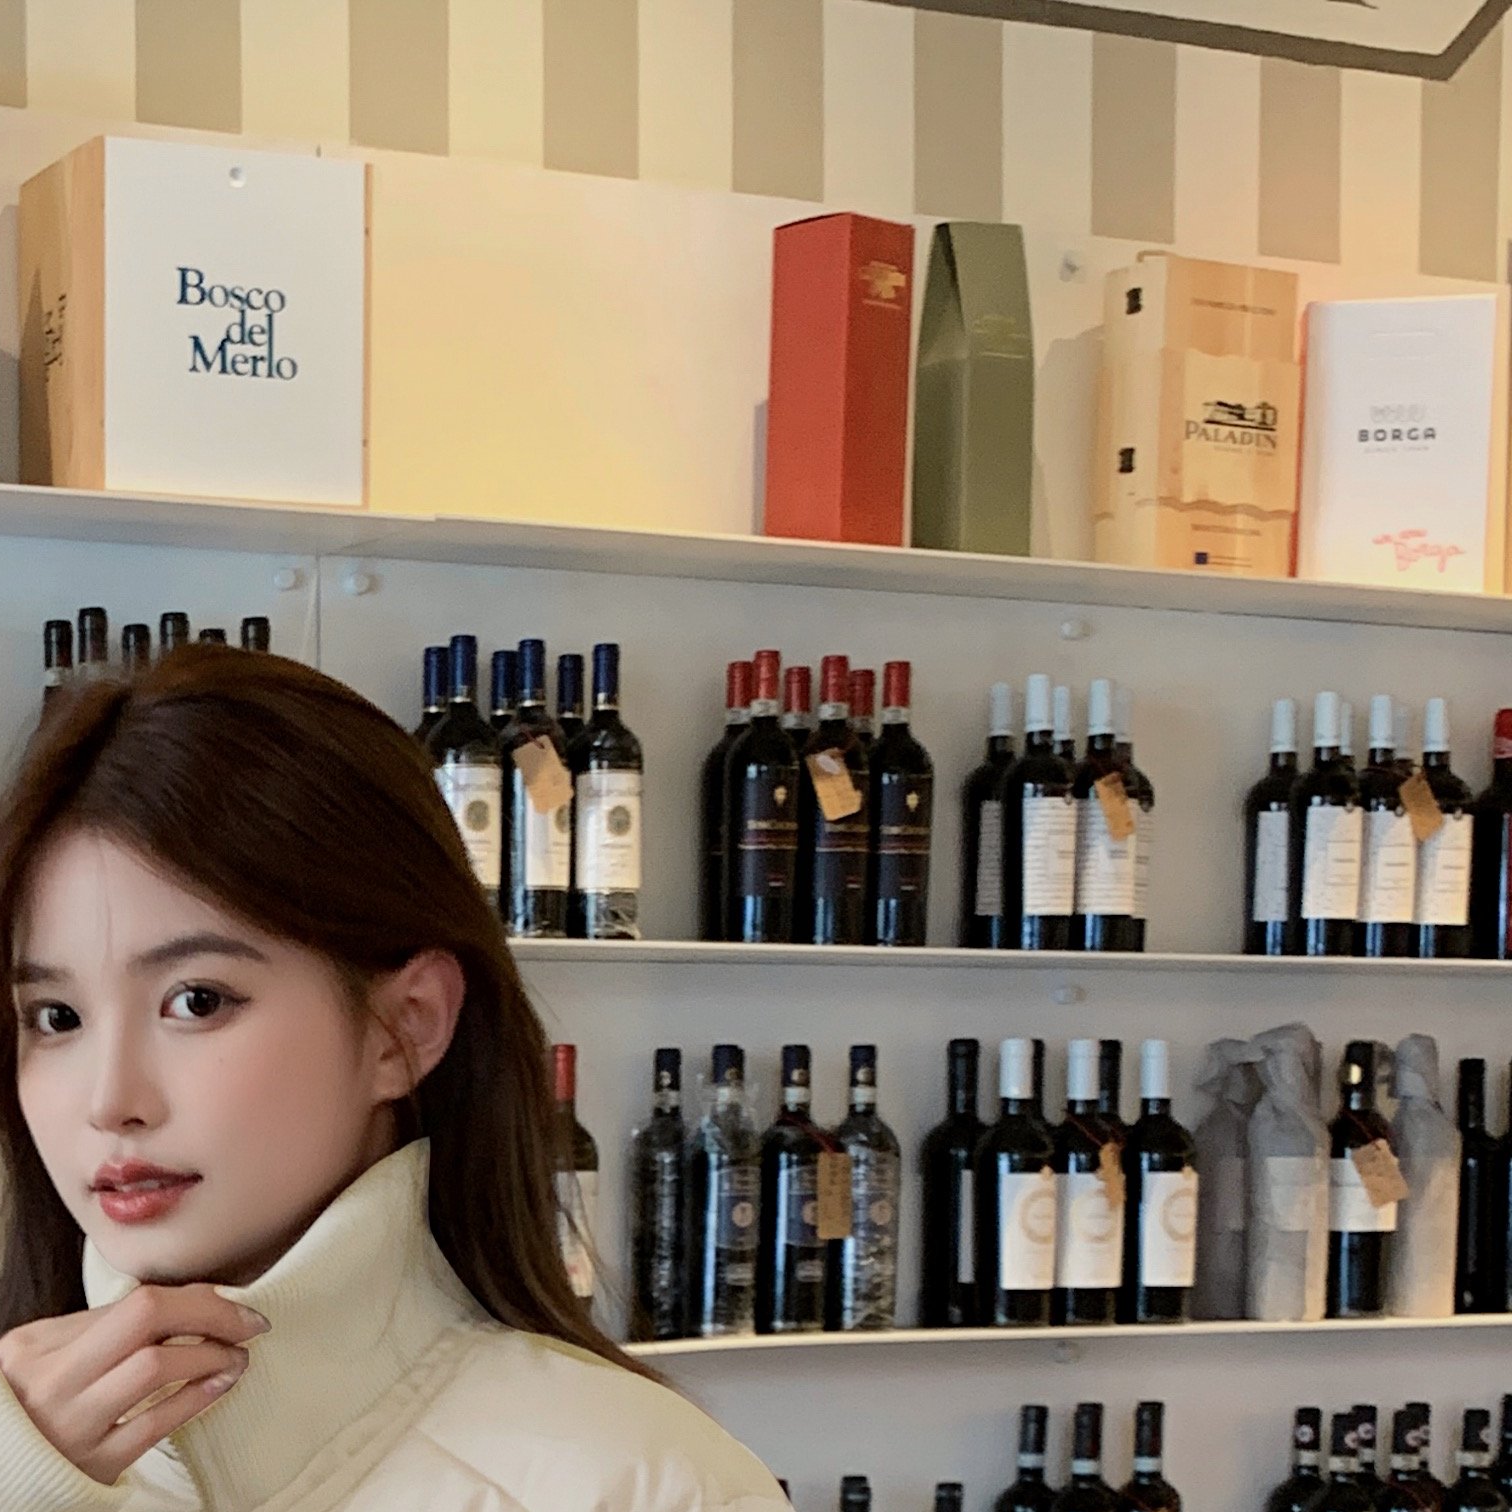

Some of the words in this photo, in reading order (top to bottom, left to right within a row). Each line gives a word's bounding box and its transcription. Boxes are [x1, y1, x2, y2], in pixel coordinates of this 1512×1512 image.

[176, 266, 286, 314] Bosco
[226, 310, 274, 346] del
[188, 334, 298, 380] Merlo
[1184, 420, 1277, 449] PALADIN
[1358, 428, 1436, 442] BORGA
